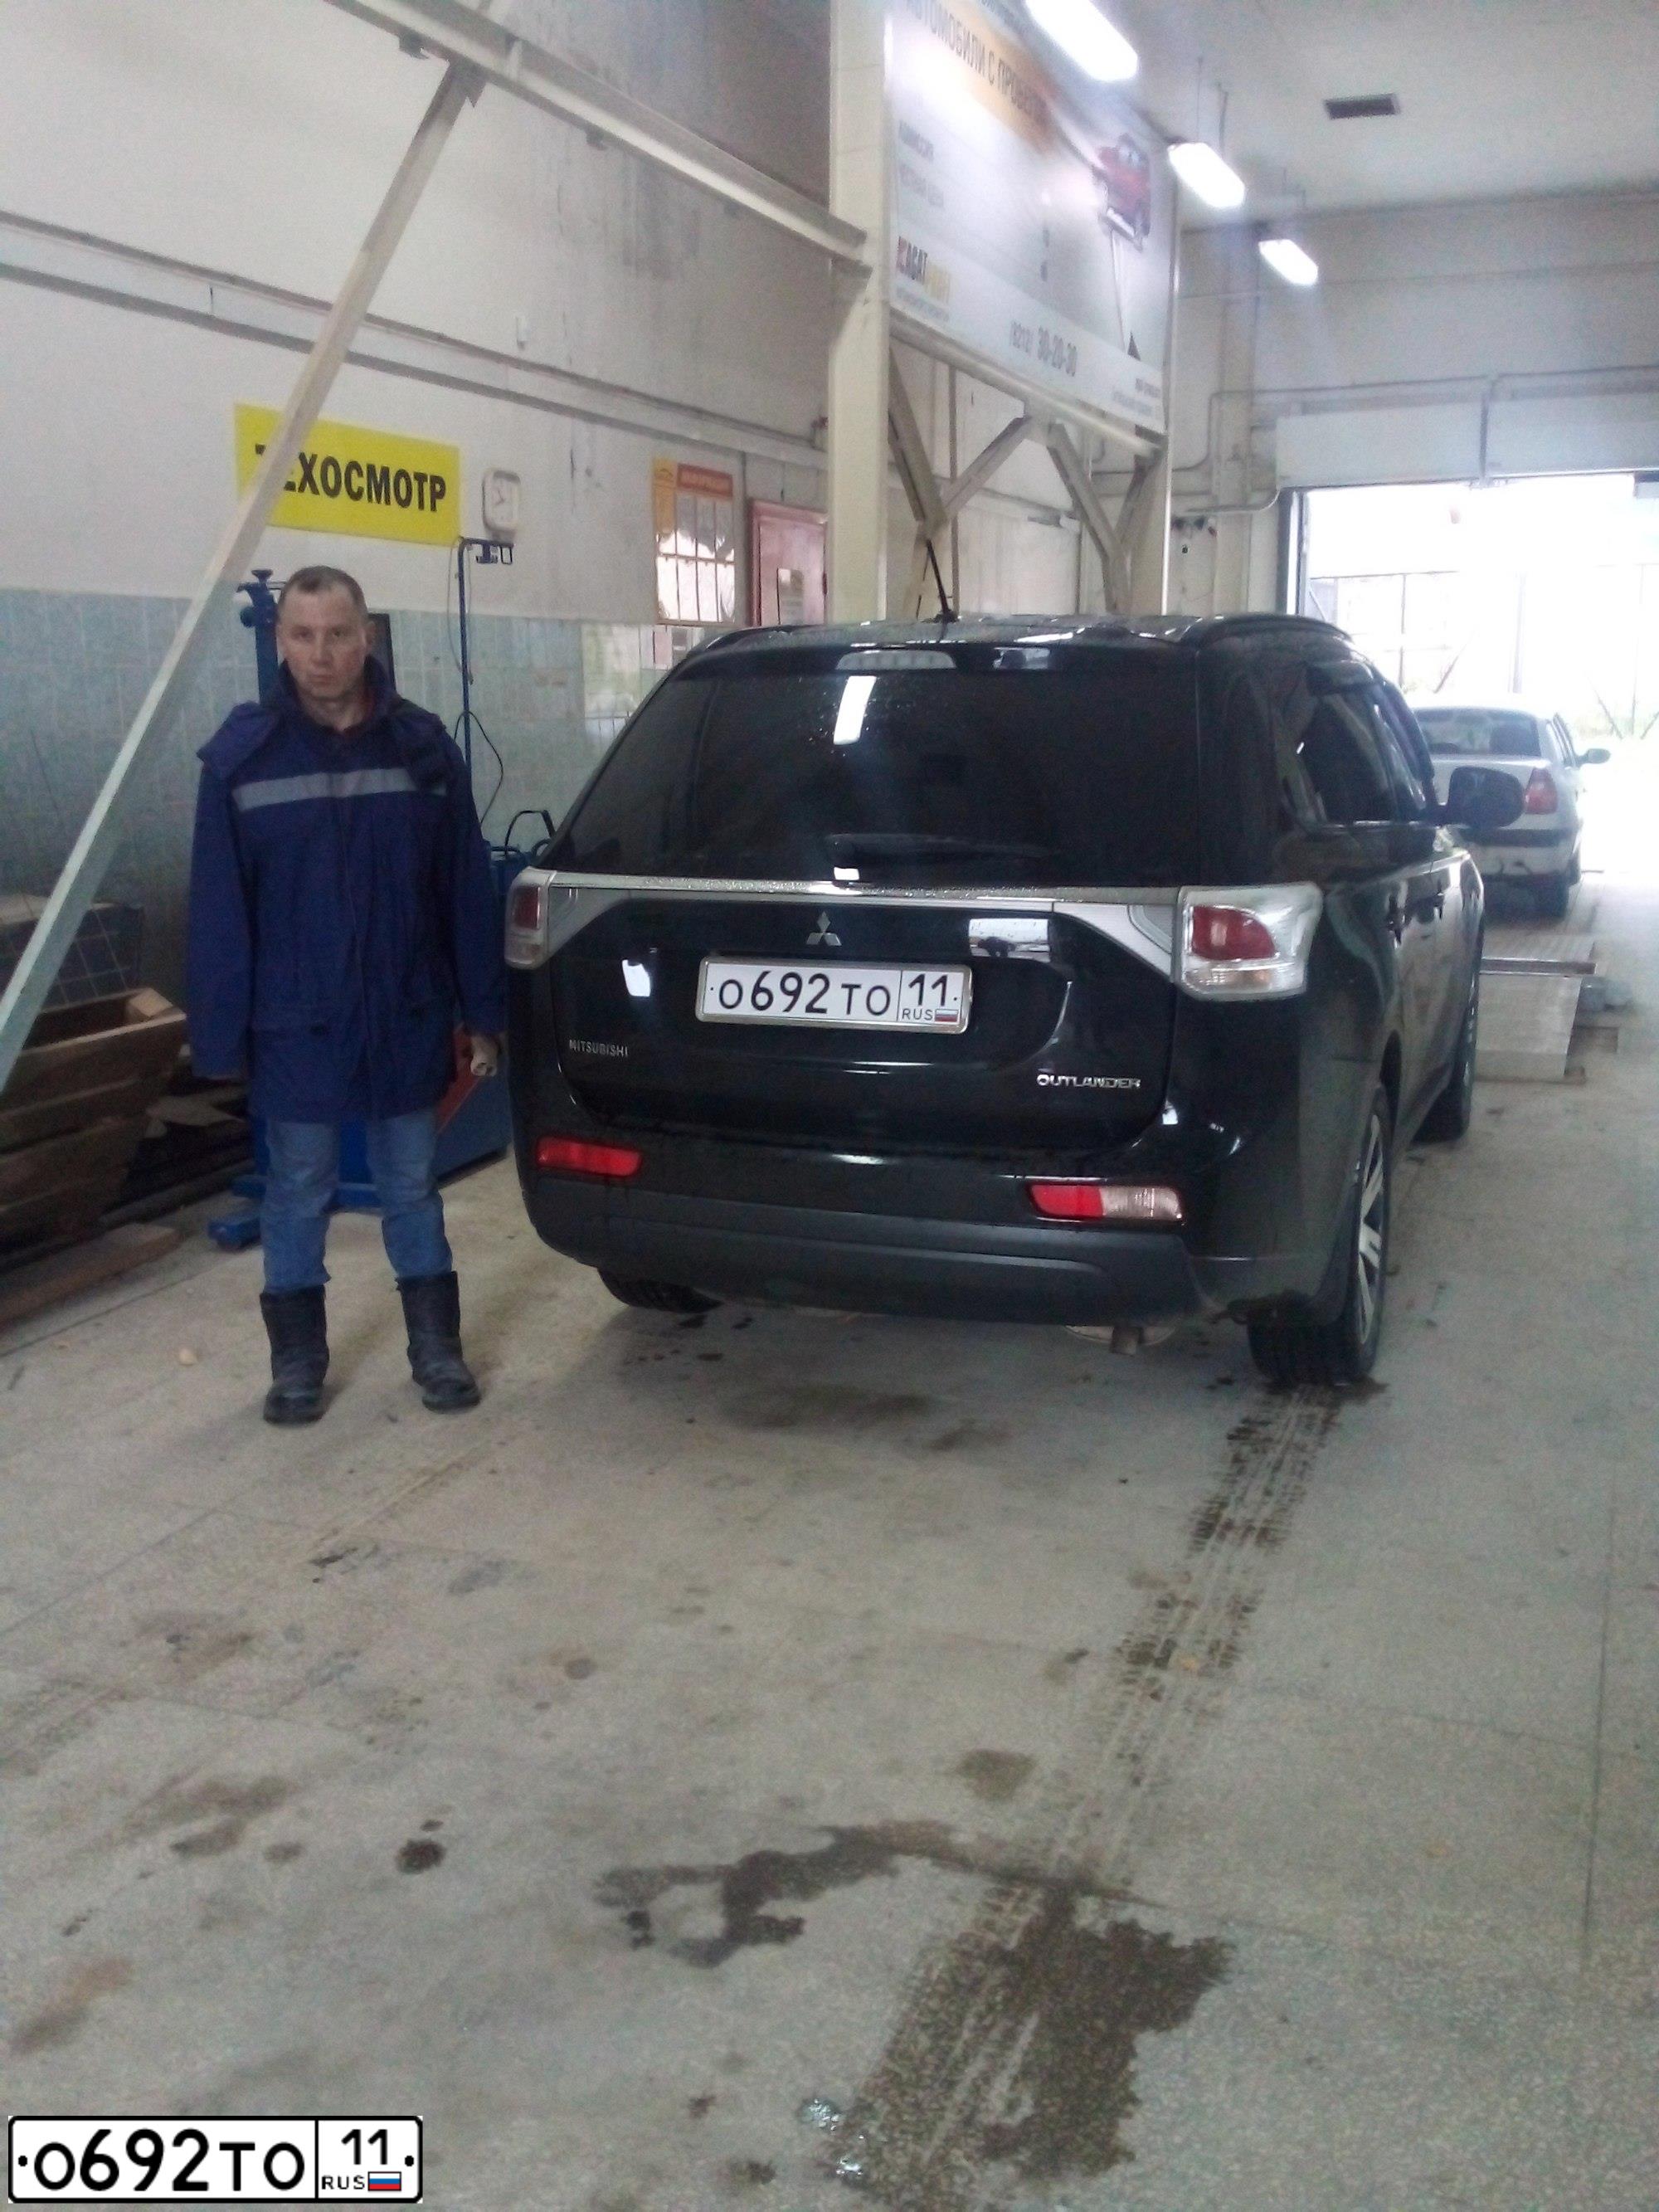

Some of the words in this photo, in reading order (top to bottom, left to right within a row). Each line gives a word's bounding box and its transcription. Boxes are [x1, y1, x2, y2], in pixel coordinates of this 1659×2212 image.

[255, 443, 446, 512] ХОСМОТР
[907, 973, 947, 1006] 11
[902, 1009, 933, 1021] RUS
[569, 1039, 628, 1057] MITSUBISHI
[1037, 1074, 1141, 1089] OUTLANDER
